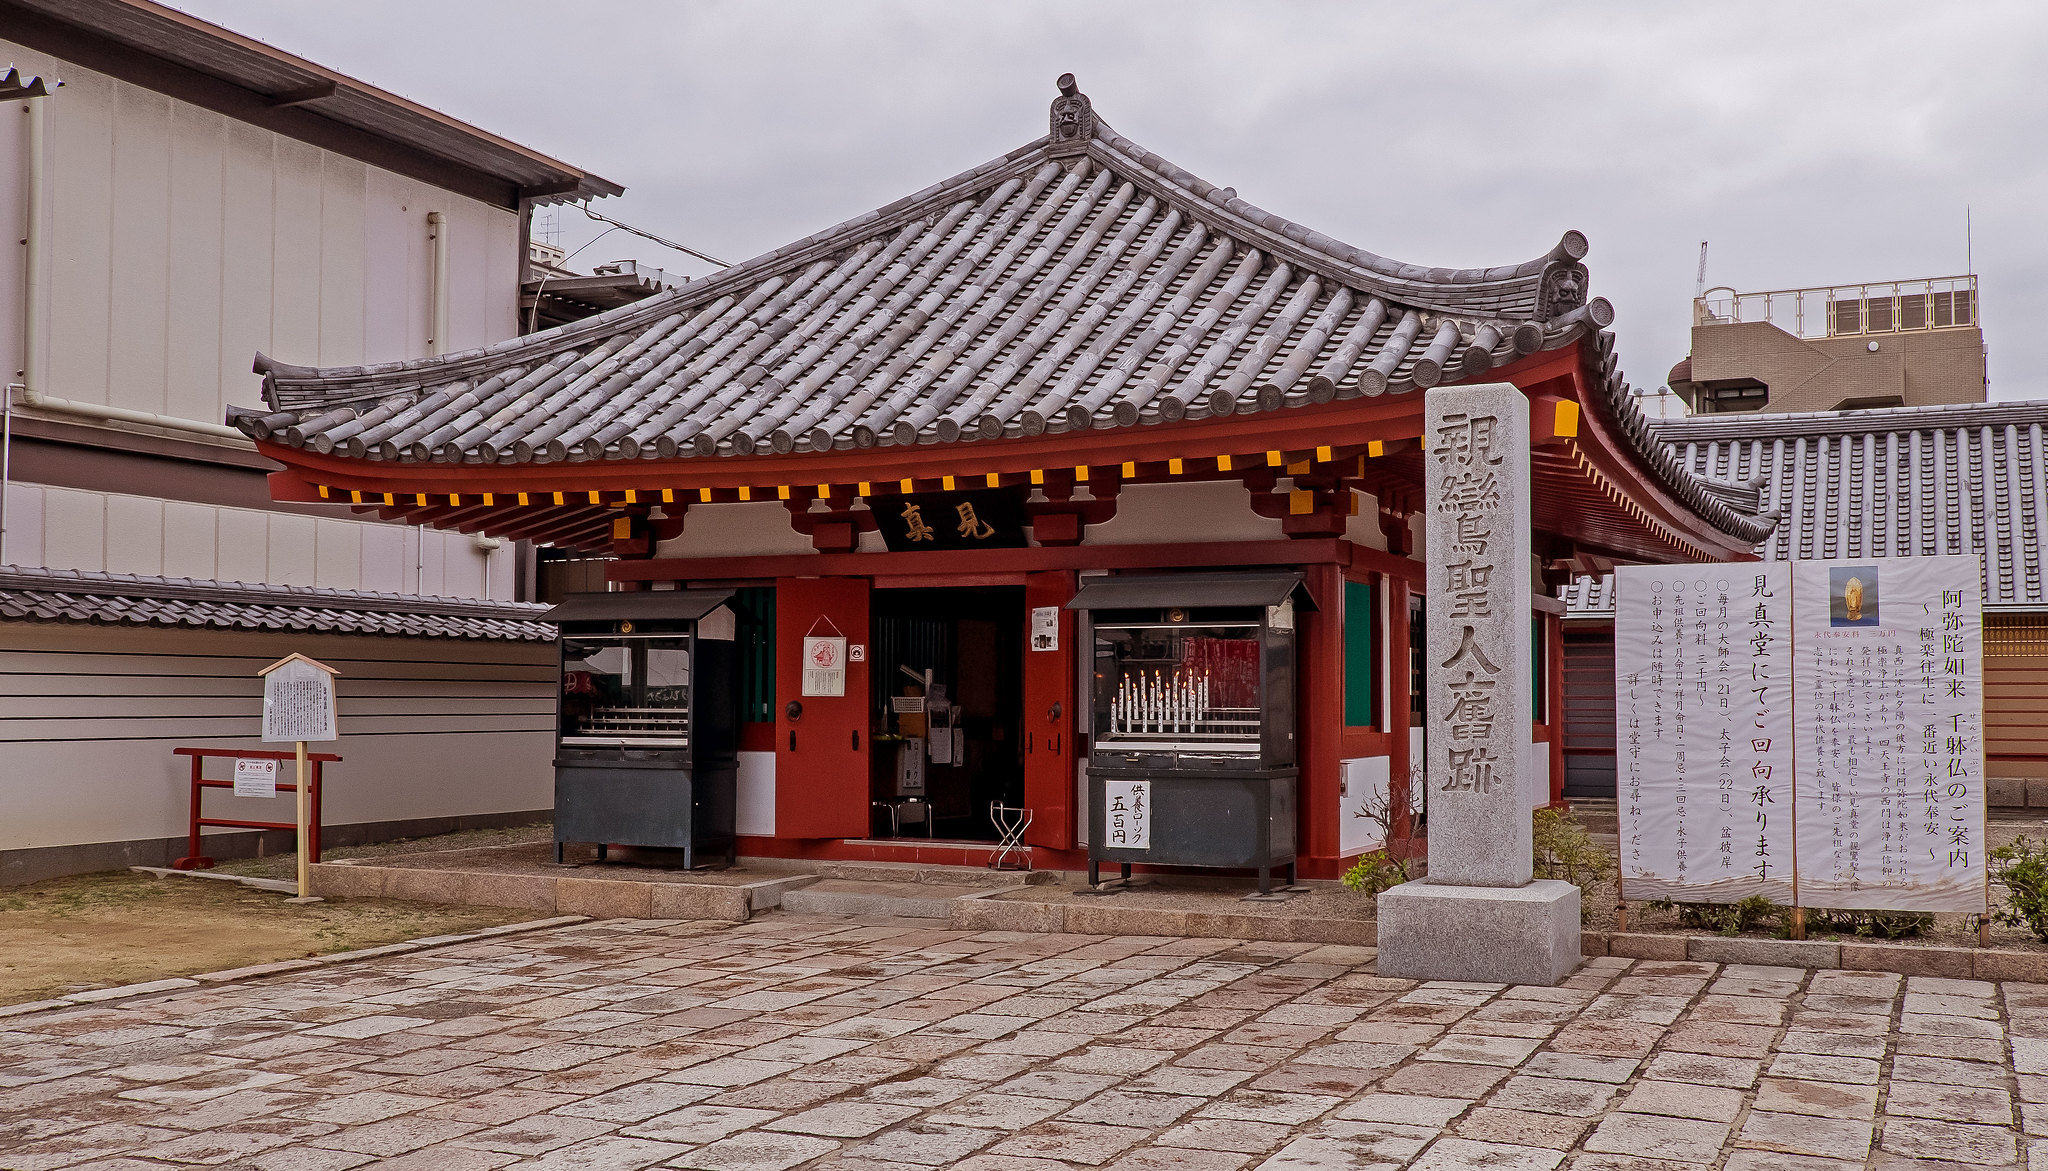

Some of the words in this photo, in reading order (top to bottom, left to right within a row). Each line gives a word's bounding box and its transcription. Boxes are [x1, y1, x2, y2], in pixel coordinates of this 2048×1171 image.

[1942, 589, 1966, 698] 阿弥陀如来
[1627, 673, 1642, 874] 詳しくは堂守にお尋ねください
[1748, 574, 1775, 883] 見真堂にてご回向承ります
[1920, 628, 1939, 836] 極楽往生に一番近い永代奉安
[1946, 713, 1969, 869] 千躰仏のご案内
[1110, 795, 1129, 844] 五百円
[1130, 784, 1145, 845] 供養ローソク
